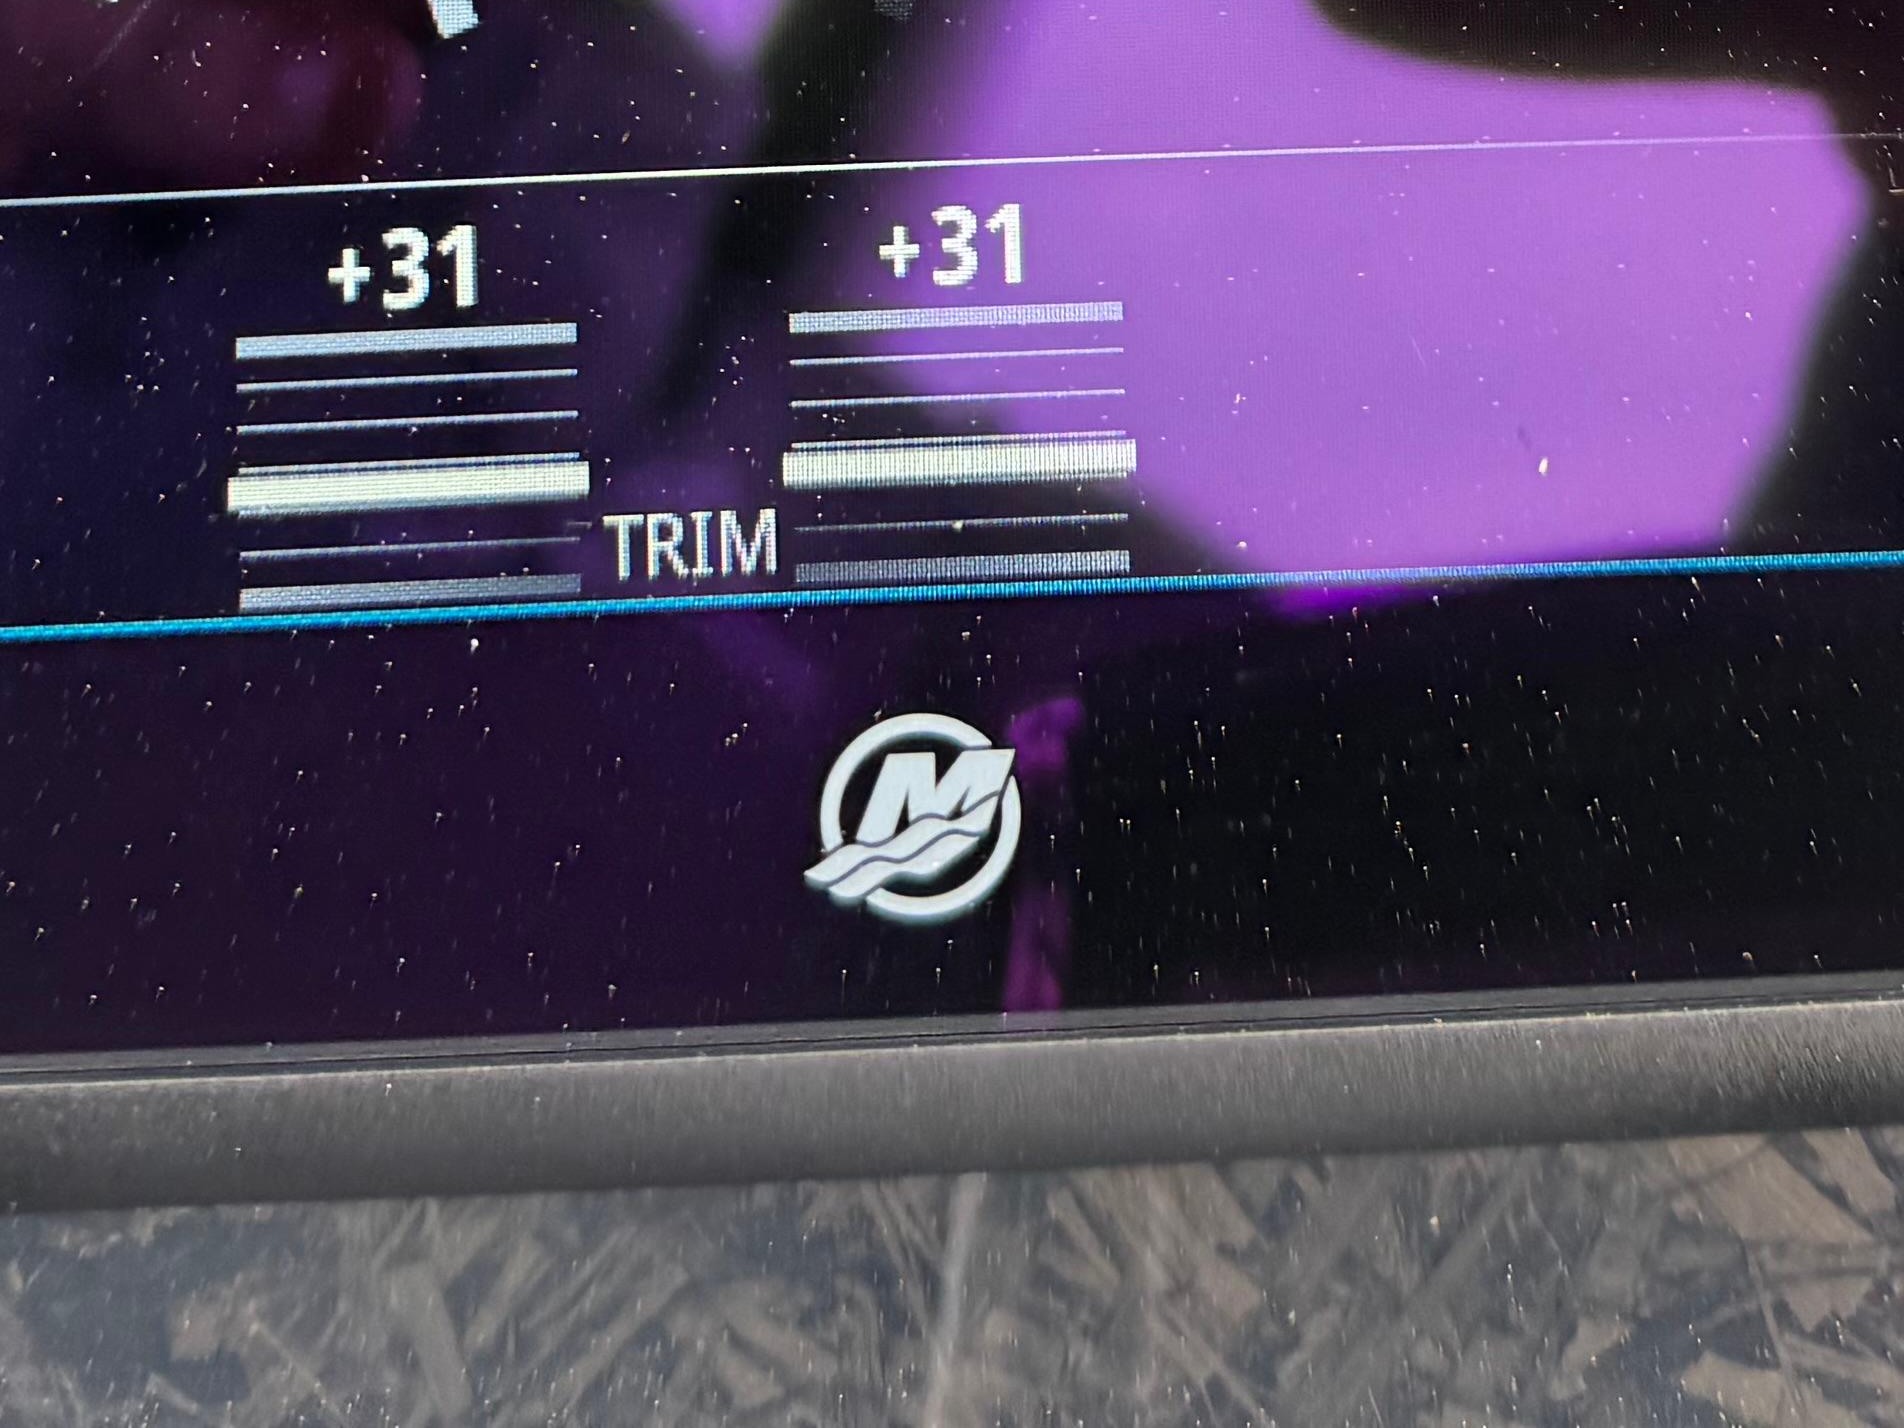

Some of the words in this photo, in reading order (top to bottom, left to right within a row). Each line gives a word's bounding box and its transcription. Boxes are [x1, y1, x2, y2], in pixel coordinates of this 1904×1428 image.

[327, 223, 481, 312] +31
[878, 202, 1026, 288] +31
[601, 507, 779, 581] TRIM
